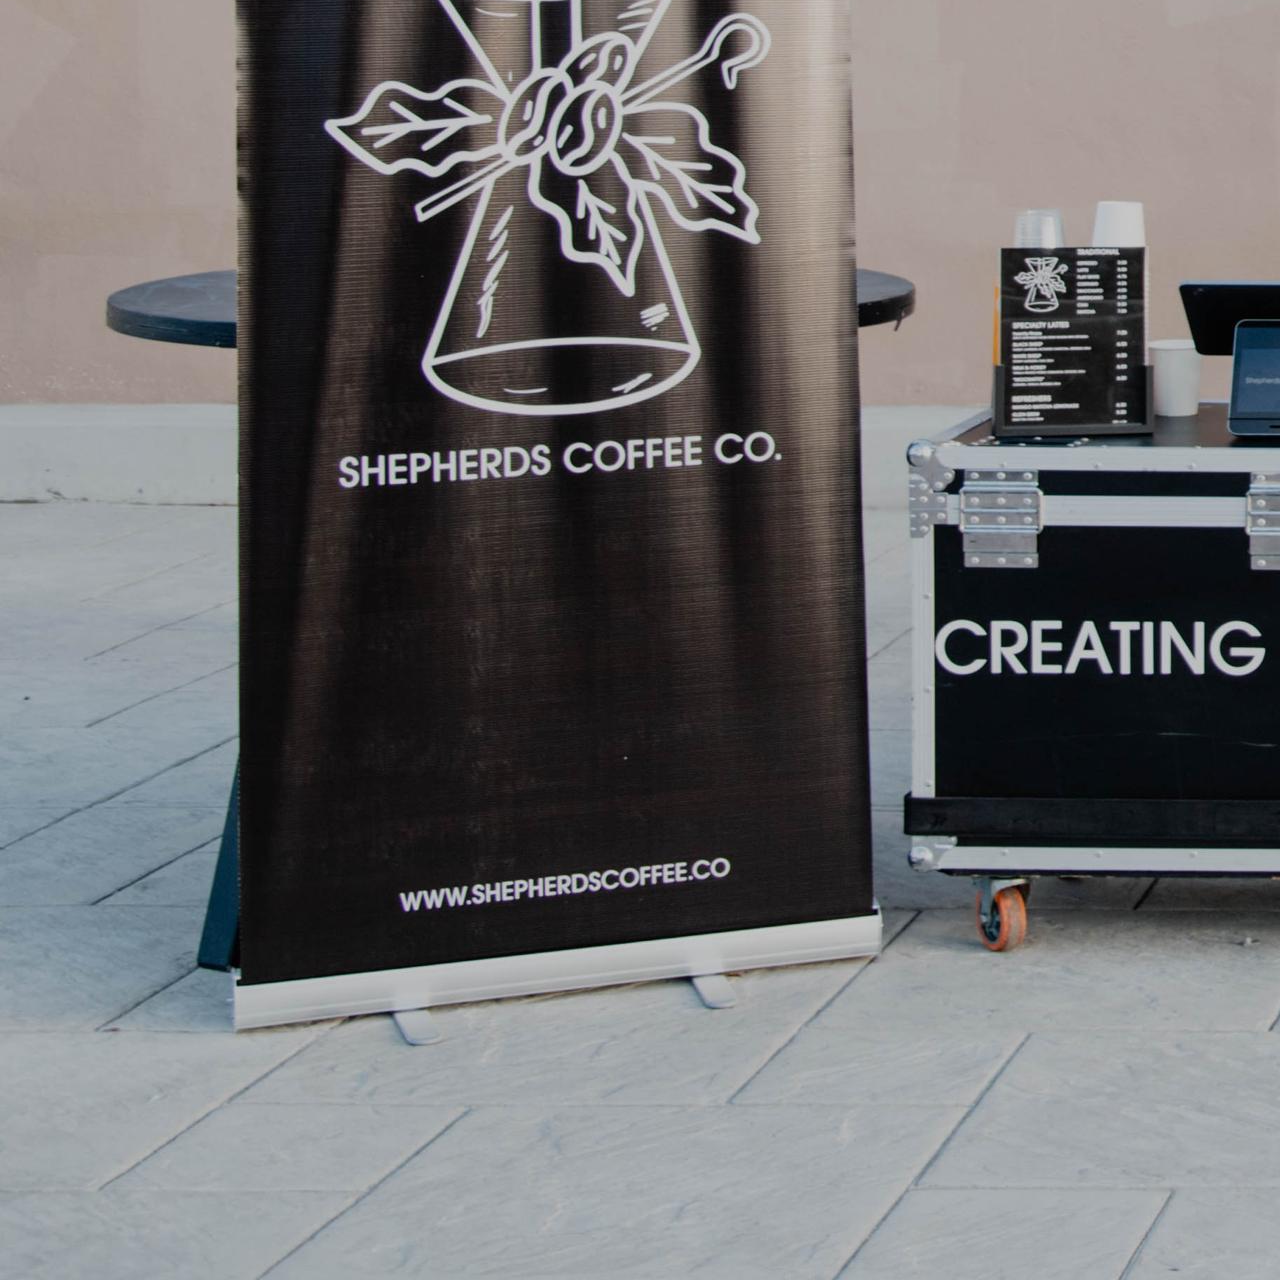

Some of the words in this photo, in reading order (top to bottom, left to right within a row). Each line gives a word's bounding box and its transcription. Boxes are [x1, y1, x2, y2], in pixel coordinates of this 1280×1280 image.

[1246, 377, 1280, 385] Shepherds
[338, 444, 552, 489] SHEPHERDS
[562, 434, 703, 474] COFFEE
[713, 430, 783, 465] CO.
[934, 618, 1266, 677] CREATING
[399, 856, 732, 913] WWW.SHEPHERDSCOFFEE.CO
